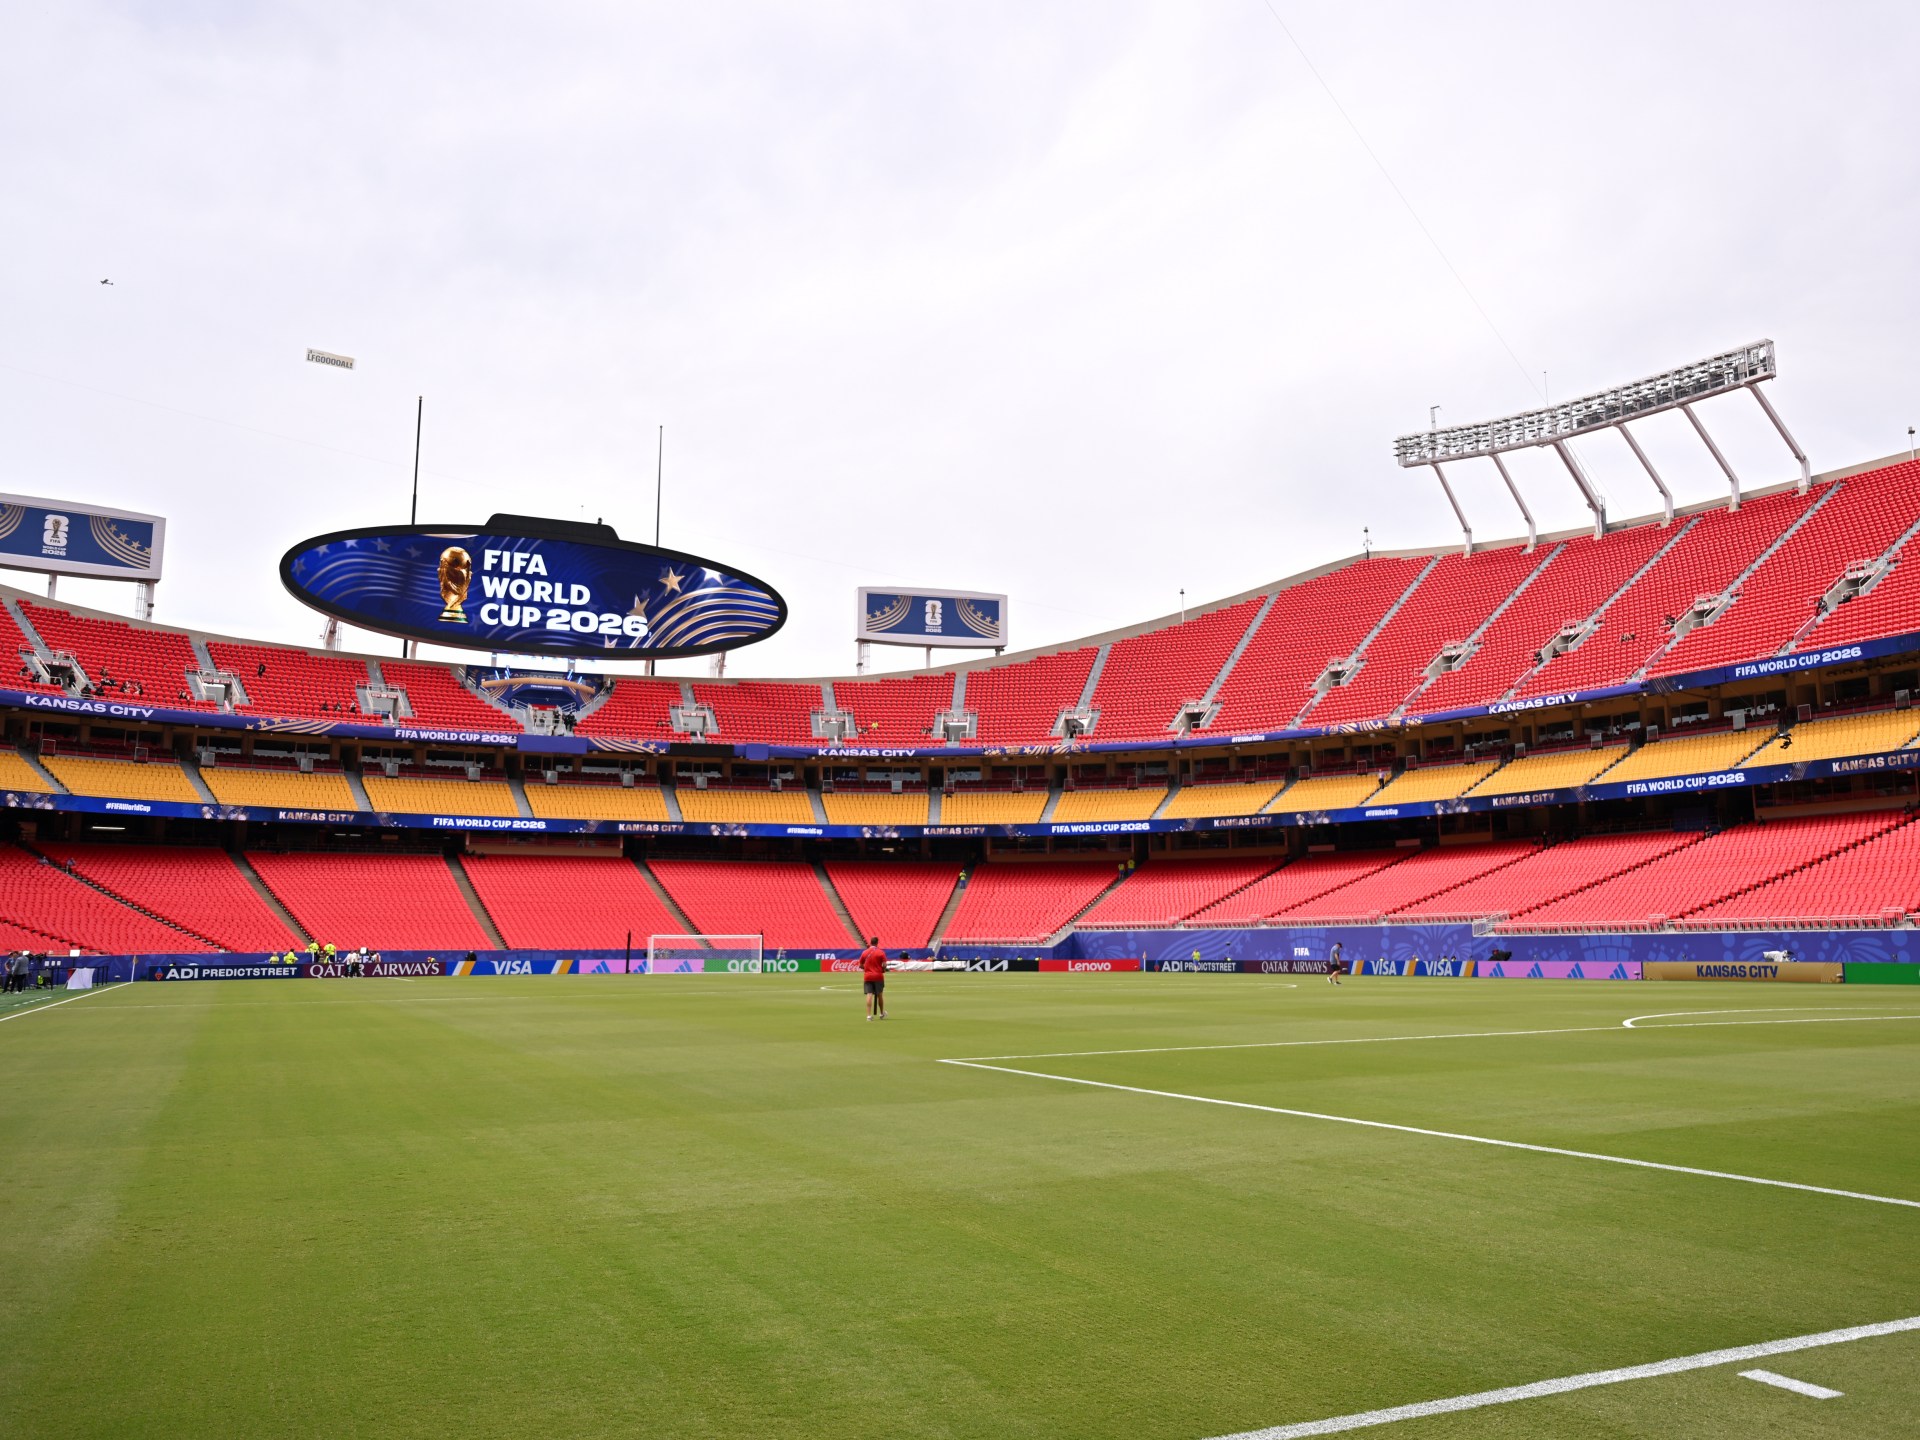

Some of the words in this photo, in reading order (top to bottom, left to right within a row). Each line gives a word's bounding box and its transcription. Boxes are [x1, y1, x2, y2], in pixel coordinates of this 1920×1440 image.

[307, 353, 353, 369] LFGOOOOAL!
[483, 549, 549, 576] FIFA
[481, 576, 591, 605] WORLD
[480, 603, 542, 627] CUP
[546, 610, 648, 637] 2026
[1735, 665, 1758, 677] FIFA
[1759, 659, 1797, 673] WORLD
[1798, 654, 1821, 667] CUP
[1822, 646, 1863, 663] 2026
[25, 695, 107, 713] KANSAS
[109, 707, 154, 718] CITY
[1488, 698, 1546, 715] KANSAS
[1547, 692, 1578, 706] CITY
[395, 729, 418, 739] FIFA
[419, 731, 459, 741] WORLD
[459, 733, 481, 742] CUP
[481, 734, 518, 744] 2026
[817, 748, 880, 757] KANSAS
[881, 749, 916, 757] CITY
[1831, 757, 1885, 772] KANSAS
[1887, 753, 1919, 766] CITY
[1626, 783, 1651, 794] FIFA
[1651, 779, 1685, 792] WORLD
[1686, 777, 1707, 788] CUP
[1708, 772, 1746, 786] 2026
[1492, 795, 1531, 807] KANSAS
[1532, 793, 1555, 803] CITY
[105, 802, 151, 813] #FIFAWorldCup
[278, 811, 327, 822] KANSAS
[328, 813, 355, 822] CITY
[433, 817, 455, 827] FIFA
[456, 819, 491, 828] WORLD
[492, 820, 512, 828] CUP
[513, 820, 546, 829] 2026
[1213, 817, 1250, 827] KANSAS
[1251, 816, 1272, 825] CITY
[618, 823, 660, 832] KANSAS
[661, 824, 684, 832] CITY
[923, 827, 962, 836] KANSAS
[963, 827, 985, 835] CITY
[1051, 825, 1071, 834] FIFA
[1071, 824, 1102, 834] WORLD
[1102, 824, 1120, 833] CUP
[1120, 823, 1150, 832] 2026
[815, 953, 837, 961] FIFA
[1293, 946, 1311, 957] FIFA
[309, 964, 366, 979] QATR
[371, 962, 440, 977] AIRWAYS
[490, 960, 533, 975] VISA
[727, 959, 799, 972] aramco
[964, 959, 1009, 972] KIA
[1068, 960, 1112, 972] Lenovo
[1161, 960, 1183, 972] ADI
[1184, 962, 1236, 972] PRDICTSTREET
[1261, 960, 1289, 974] QATAR
[1291, 960, 1328, 973] AIRWAYS
[1370, 960, 1397, 975] VISA
[1425, 960, 1454, 977] VISA
[1696, 964, 1747, 979] KANSAS
[1748, 965, 1779, 979] CITY
[166, 967, 199, 980] ADI
[202, 967, 298, 978] PREDICTSTREET
